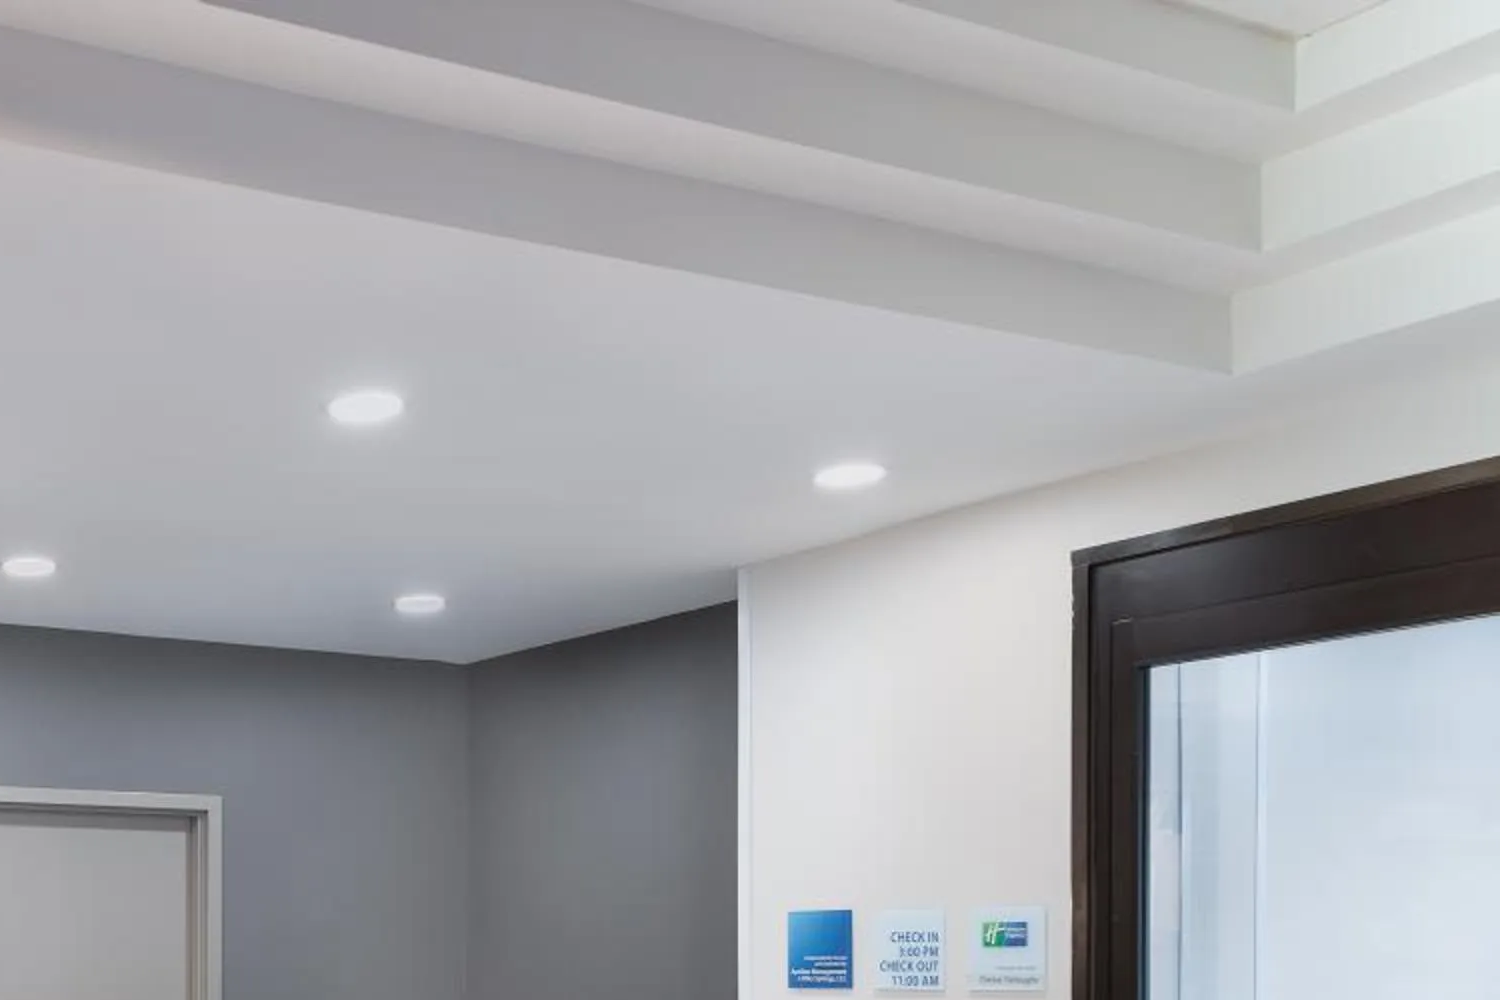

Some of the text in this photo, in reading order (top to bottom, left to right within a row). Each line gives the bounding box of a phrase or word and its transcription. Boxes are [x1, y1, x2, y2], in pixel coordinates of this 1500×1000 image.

[890, 931, 939, 943] CHECK IN
[923, 946, 939, 957] PM
[879, 959, 939, 972] CHECK OUT
[891, 975, 939, 987] 11:00 AM
